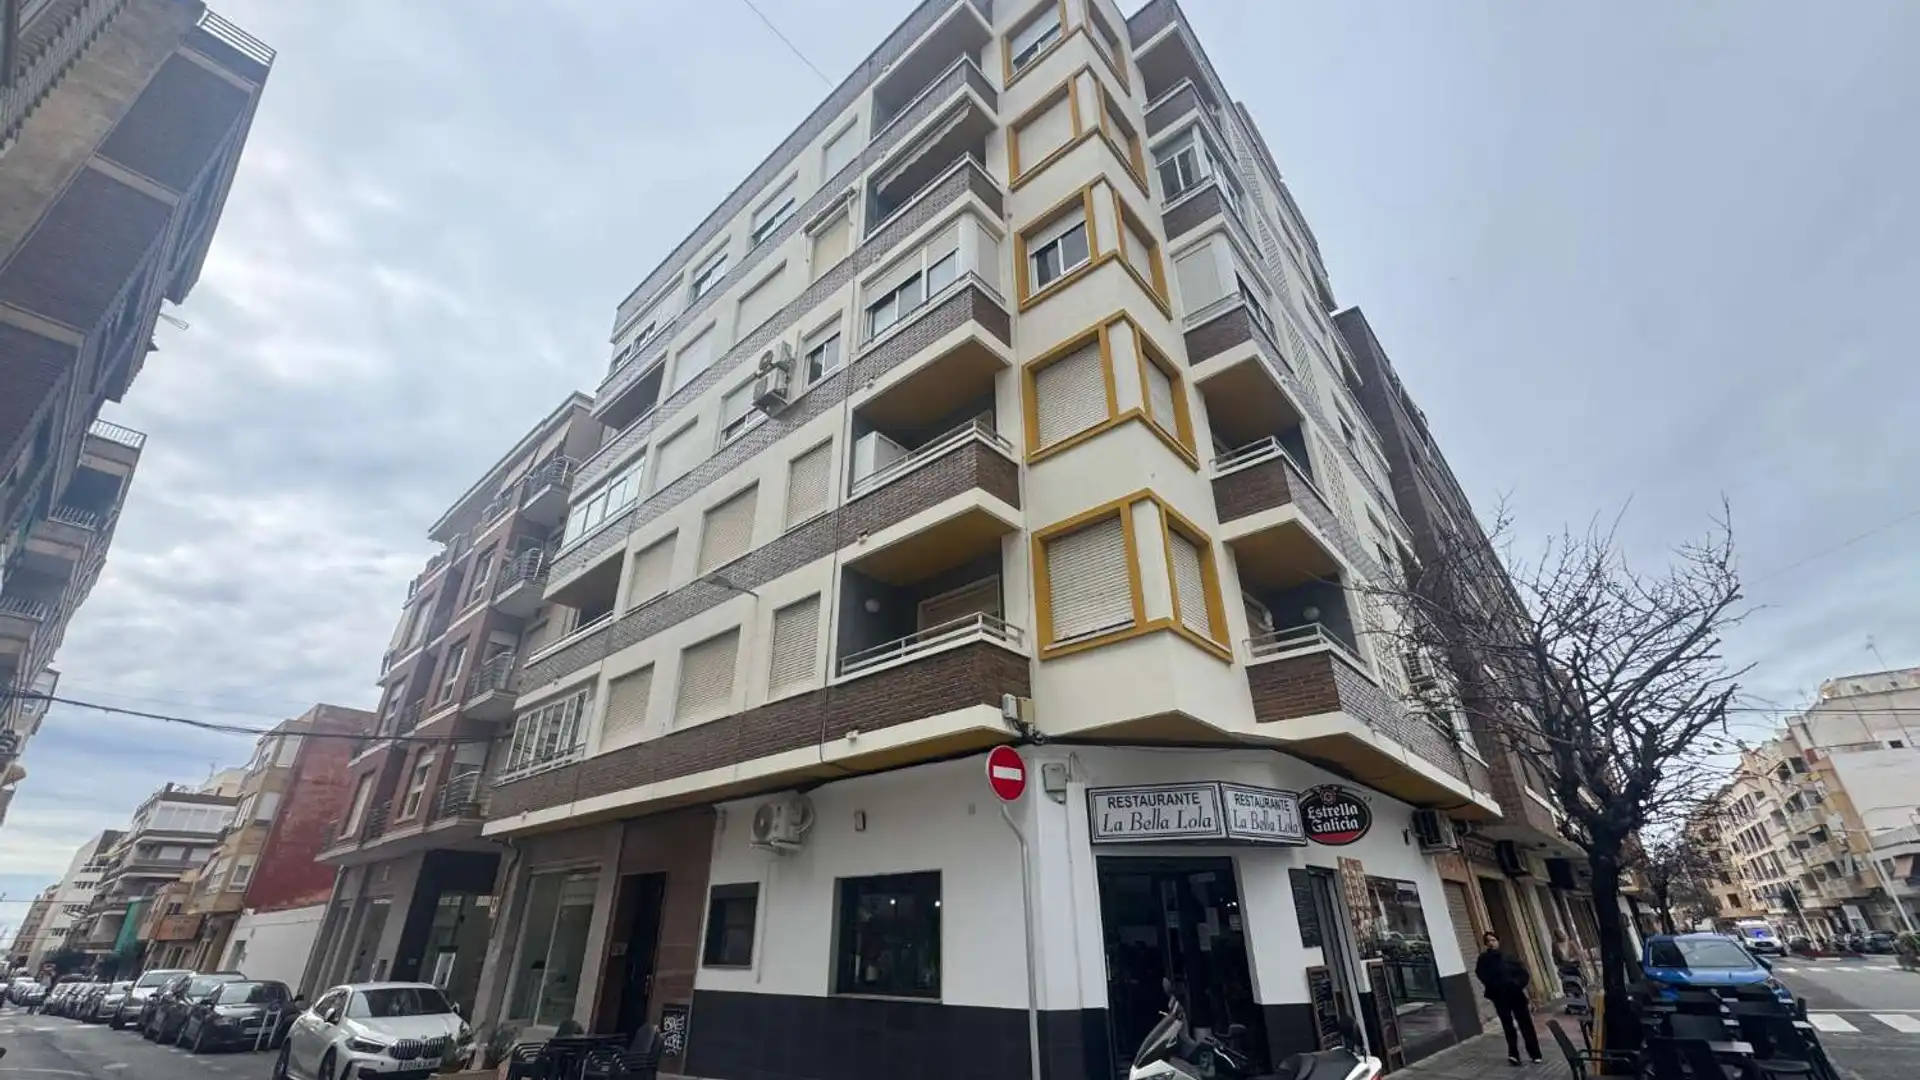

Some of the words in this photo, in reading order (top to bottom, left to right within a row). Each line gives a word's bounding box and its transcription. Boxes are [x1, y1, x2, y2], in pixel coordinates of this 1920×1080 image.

[1107, 792, 1201, 809] RESTAURANTE
[1234, 793, 1290, 812] RESTAURANTE
[1103, 813, 1123, 832] La
[1130, 807, 1169, 831] Bella
[1177, 805, 1211, 829] Lola
[1307, 803, 1359, 819] Estrella
[1233, 809, 1247, 829] La
[1251, 810, 1275, 832] Bella
[1277, 812, 1299, 834] Lola
[1312, 816, 1359, 833] Galicia
